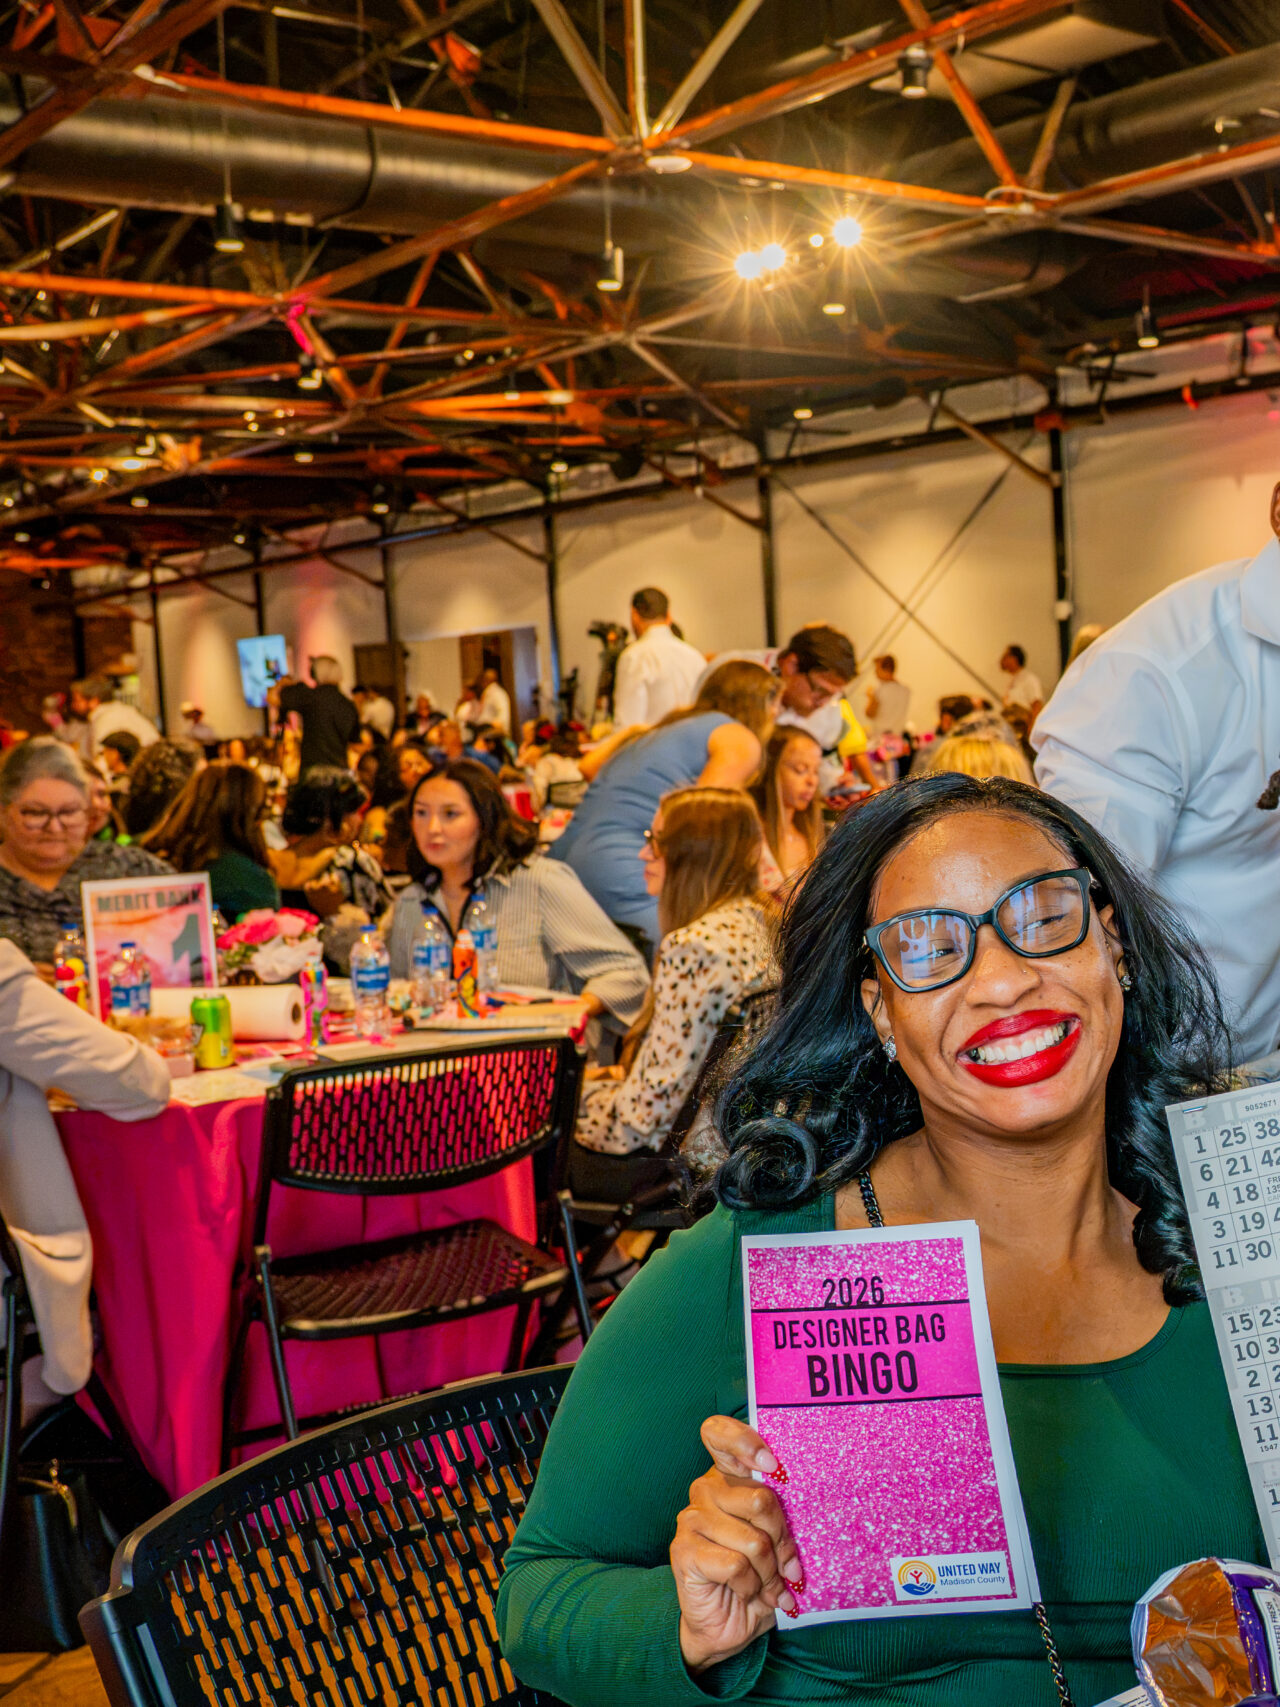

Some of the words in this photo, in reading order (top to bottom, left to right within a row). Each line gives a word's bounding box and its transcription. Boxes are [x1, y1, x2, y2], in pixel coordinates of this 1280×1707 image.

[172, 914, 204, 985] 1
[1245, 1099, 1277, 1112] 9052671
[1195, 1136, 1206, 1153] 1
[1220, 1127, 1246, 1148] 25
[1255, 1119, 1280, 1139] 38
[1200, 1164, 1213, 1181] 6
[1226, 1156, 1252, 1176] 21
[1207, 1192, 1219, 1209] 4
[1233, 1184, 1259, 1204] 18
[1213, 1221, 1225, 1238] 3
[1240, 1212, 1264, 1233] 19
[1213, 1248, 1238, 1268] 11
[1245, 1241, 1271, 1261] 30
[822, 1275, 885, 1308] 2026
[773, 1317, 888, 1350] DESIGNER
[895, 1313, 946, 1345] BAG
[1228, 1313, 1253, 1334] 15
[1234, 1341, 1259, 1361] 10
[806, 1350, 919, 1398] BINGO
[1247, 1370, 1260, 1388] 2
[1248, 1397, 1272, 1416] 13
[1254, 1424, 1278, 1443] 11
[938, 1564, 976, 1577] UNITED
[978, 1562, 1001, 1575] WAY
[940, 1577, 974, 1586] Madison
[976, 1574, 1005, 1586] County
[1265, 1601, 1279, 1623] FRESH
